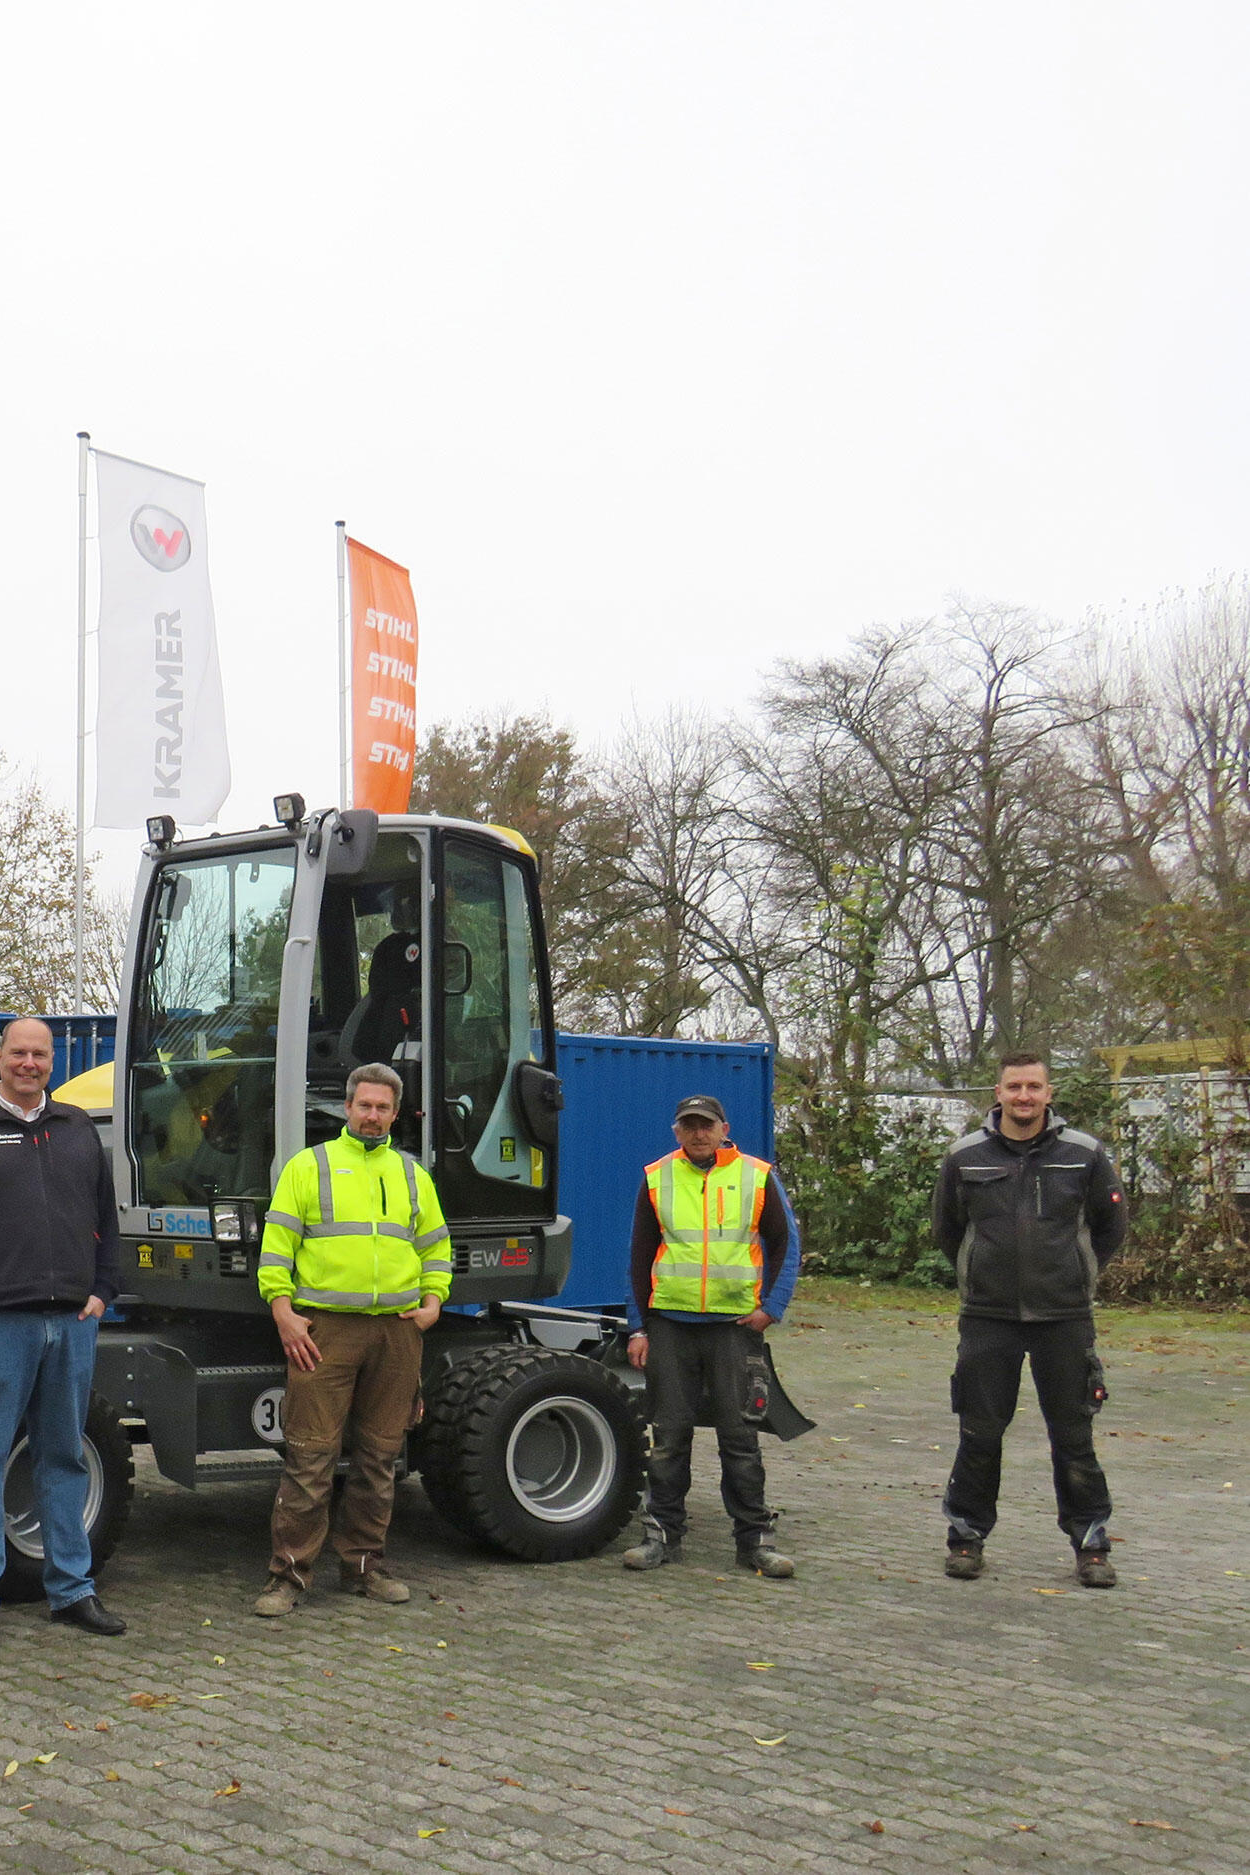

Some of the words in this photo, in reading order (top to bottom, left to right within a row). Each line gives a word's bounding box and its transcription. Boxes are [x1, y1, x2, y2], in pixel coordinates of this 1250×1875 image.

[364, 607, 416, 644] STIHL
[366, 651, 417, 687] STIHL
[152, 607, 184, 799] KRAMER
[367, 695, 416, 731] STIHL
[368, 740, 411, 773] STIH
[469, 1247, 529, 1269] EW65
[261, 1397, 286, 1433] 3
